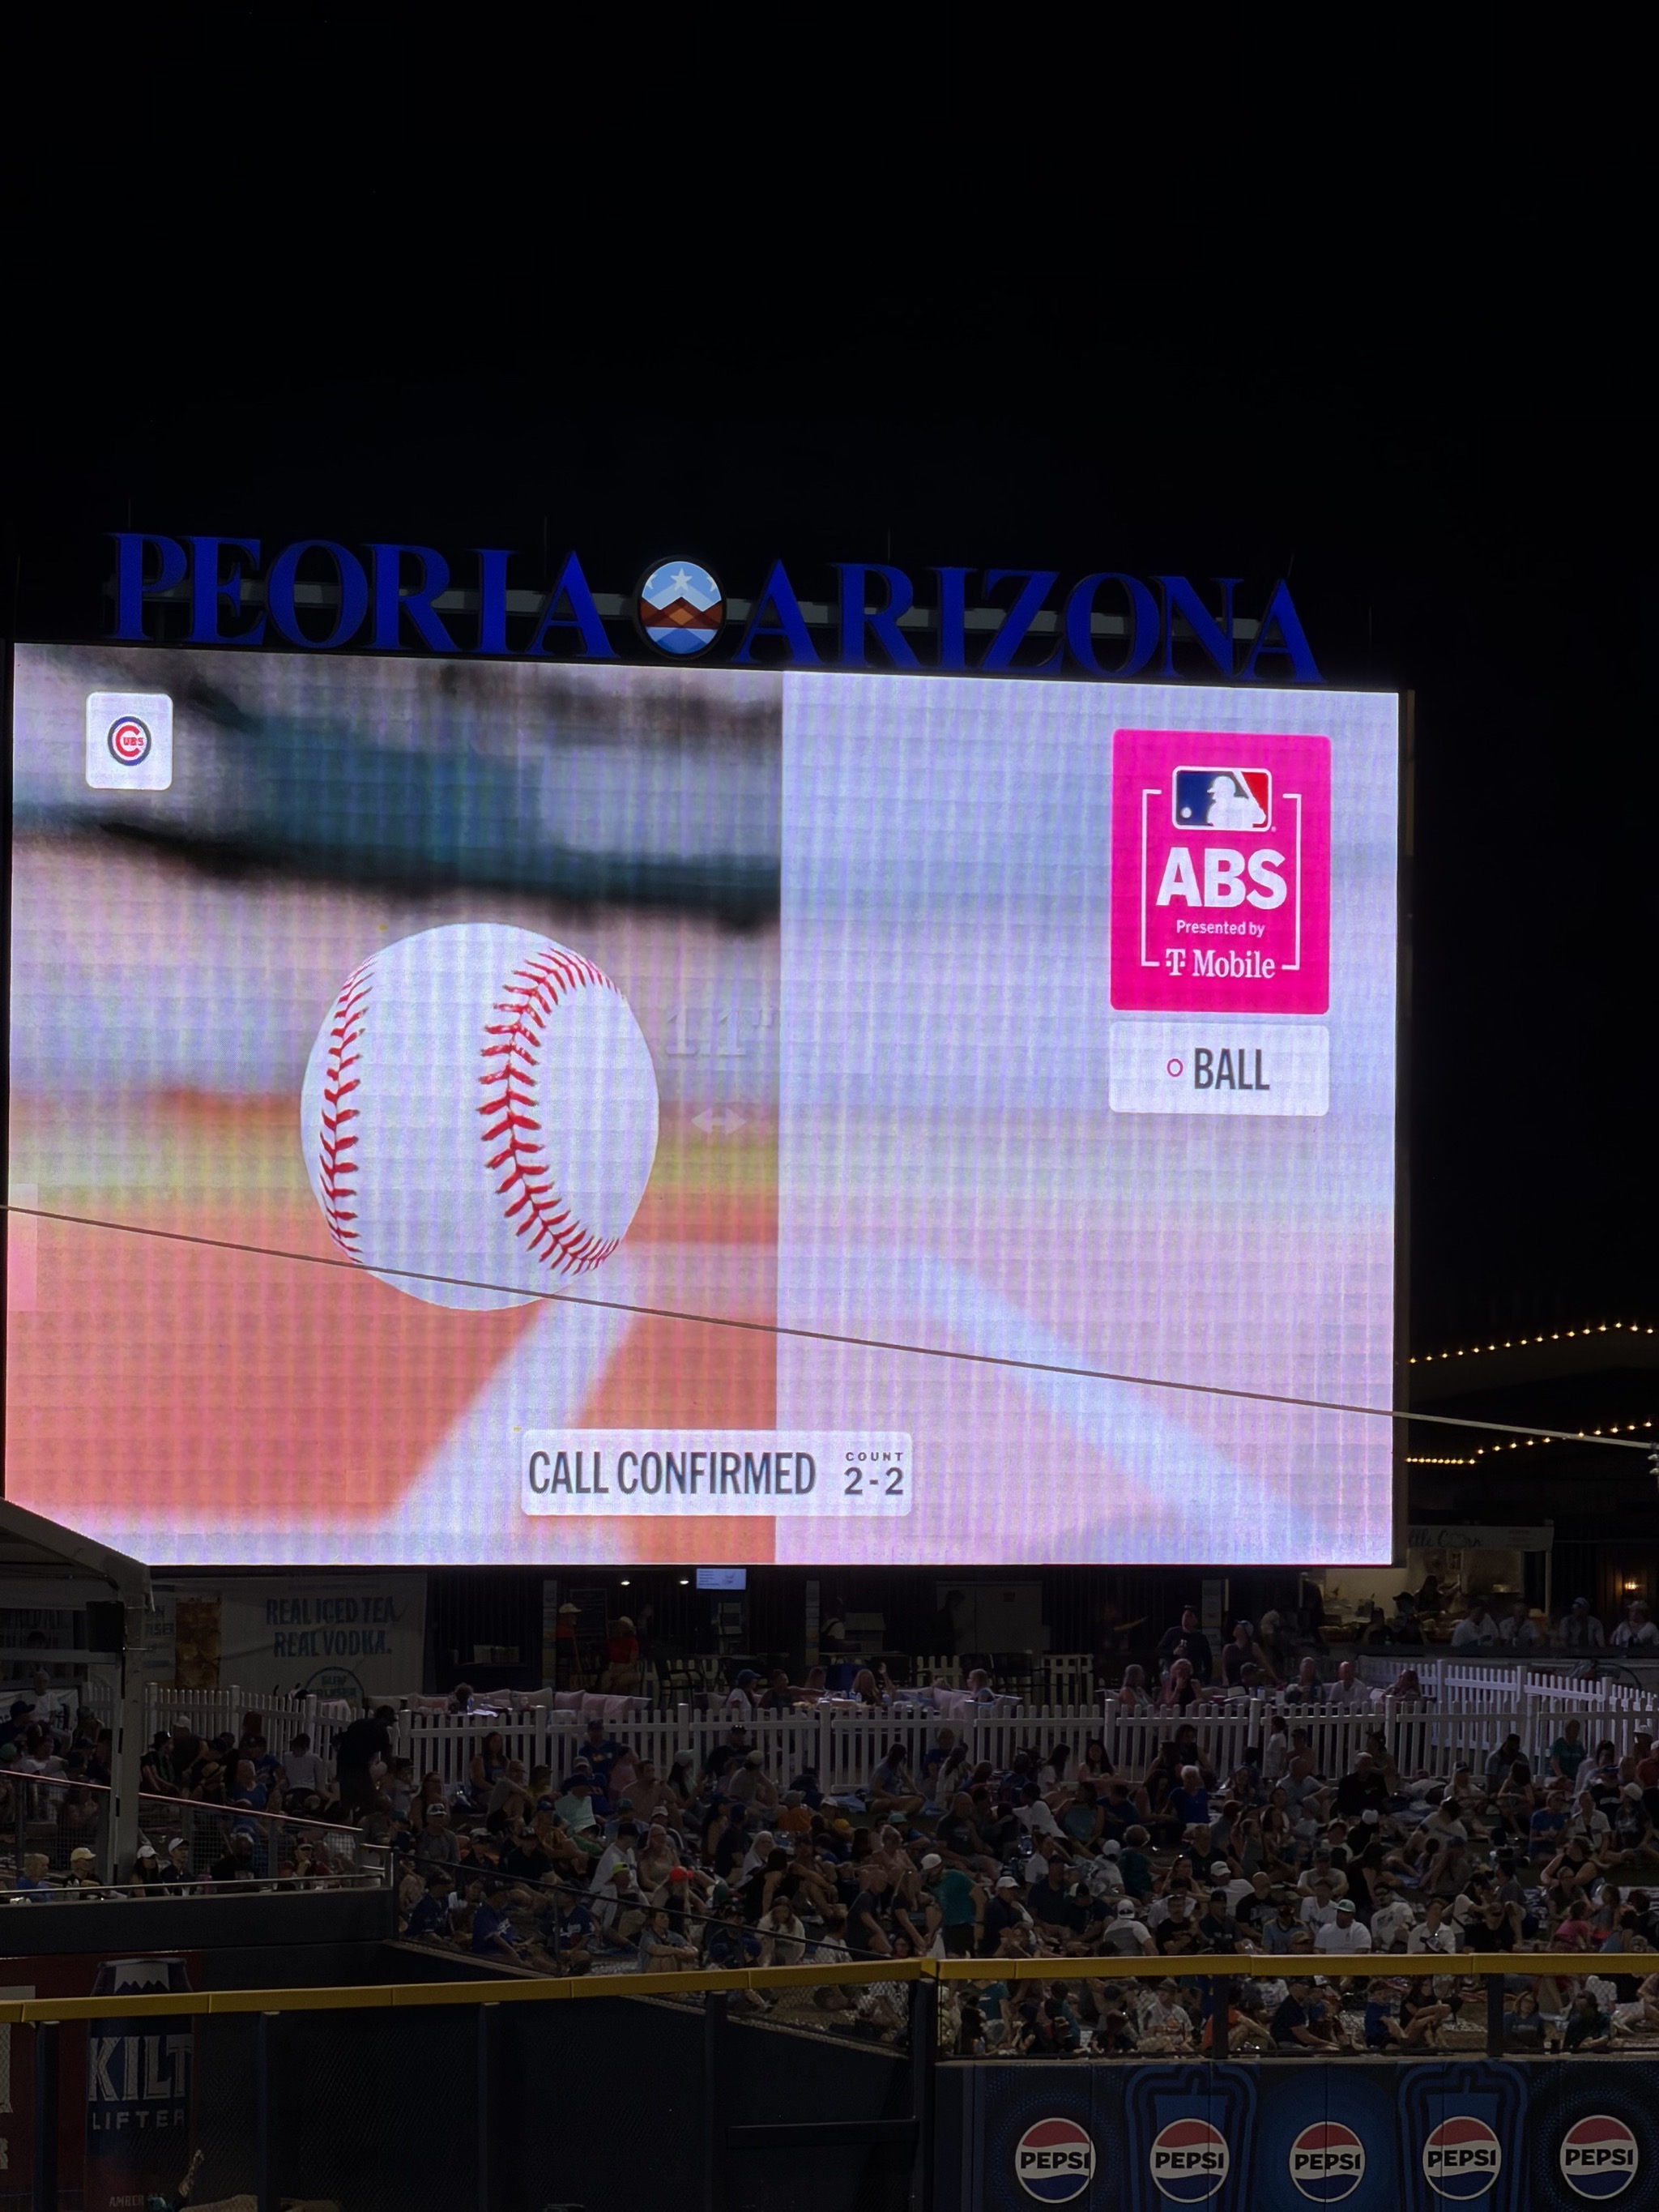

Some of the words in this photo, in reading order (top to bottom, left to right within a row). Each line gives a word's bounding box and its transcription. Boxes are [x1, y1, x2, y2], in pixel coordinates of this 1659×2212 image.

[105, 531, 621, 658] PEORIA
[728, 557, 1328, 683] ARIZONA
[1156, 846, 1287, 910] ABS
[1176, 919, 1246, 935] Presented
[1249, 922, 1265, 938] by
[1194, 1048, 1270, 1091] BALL
[845, 1451, 904, 1462] COUNT
[529, 1451, 609, 1494] CALL
[618, 1451, 817, 1495] CONFIRMED
[844, 1467, 904, 1496] 2-2
[267, 1598, 312, 1625] REAL
[316, 1597, 358, 1624] ICED
[274, 1631, 320, 1657] REAL
[323, 1629, 392, 1655] VODKA.
[87, 2032, 195, 2103] KILT
[92, 2108, 186, 2131] LIFTER
[1021, 2151, 1090, 2169] PEPSI
[1155, 2152, 1224, 2169] PEPSI
[1295, 2154, 1361, 2170] PEPSI
[1427, 2149, 1496, 2167] PEPSI
[1565, 2148, 1633, 2166] PEPSI
